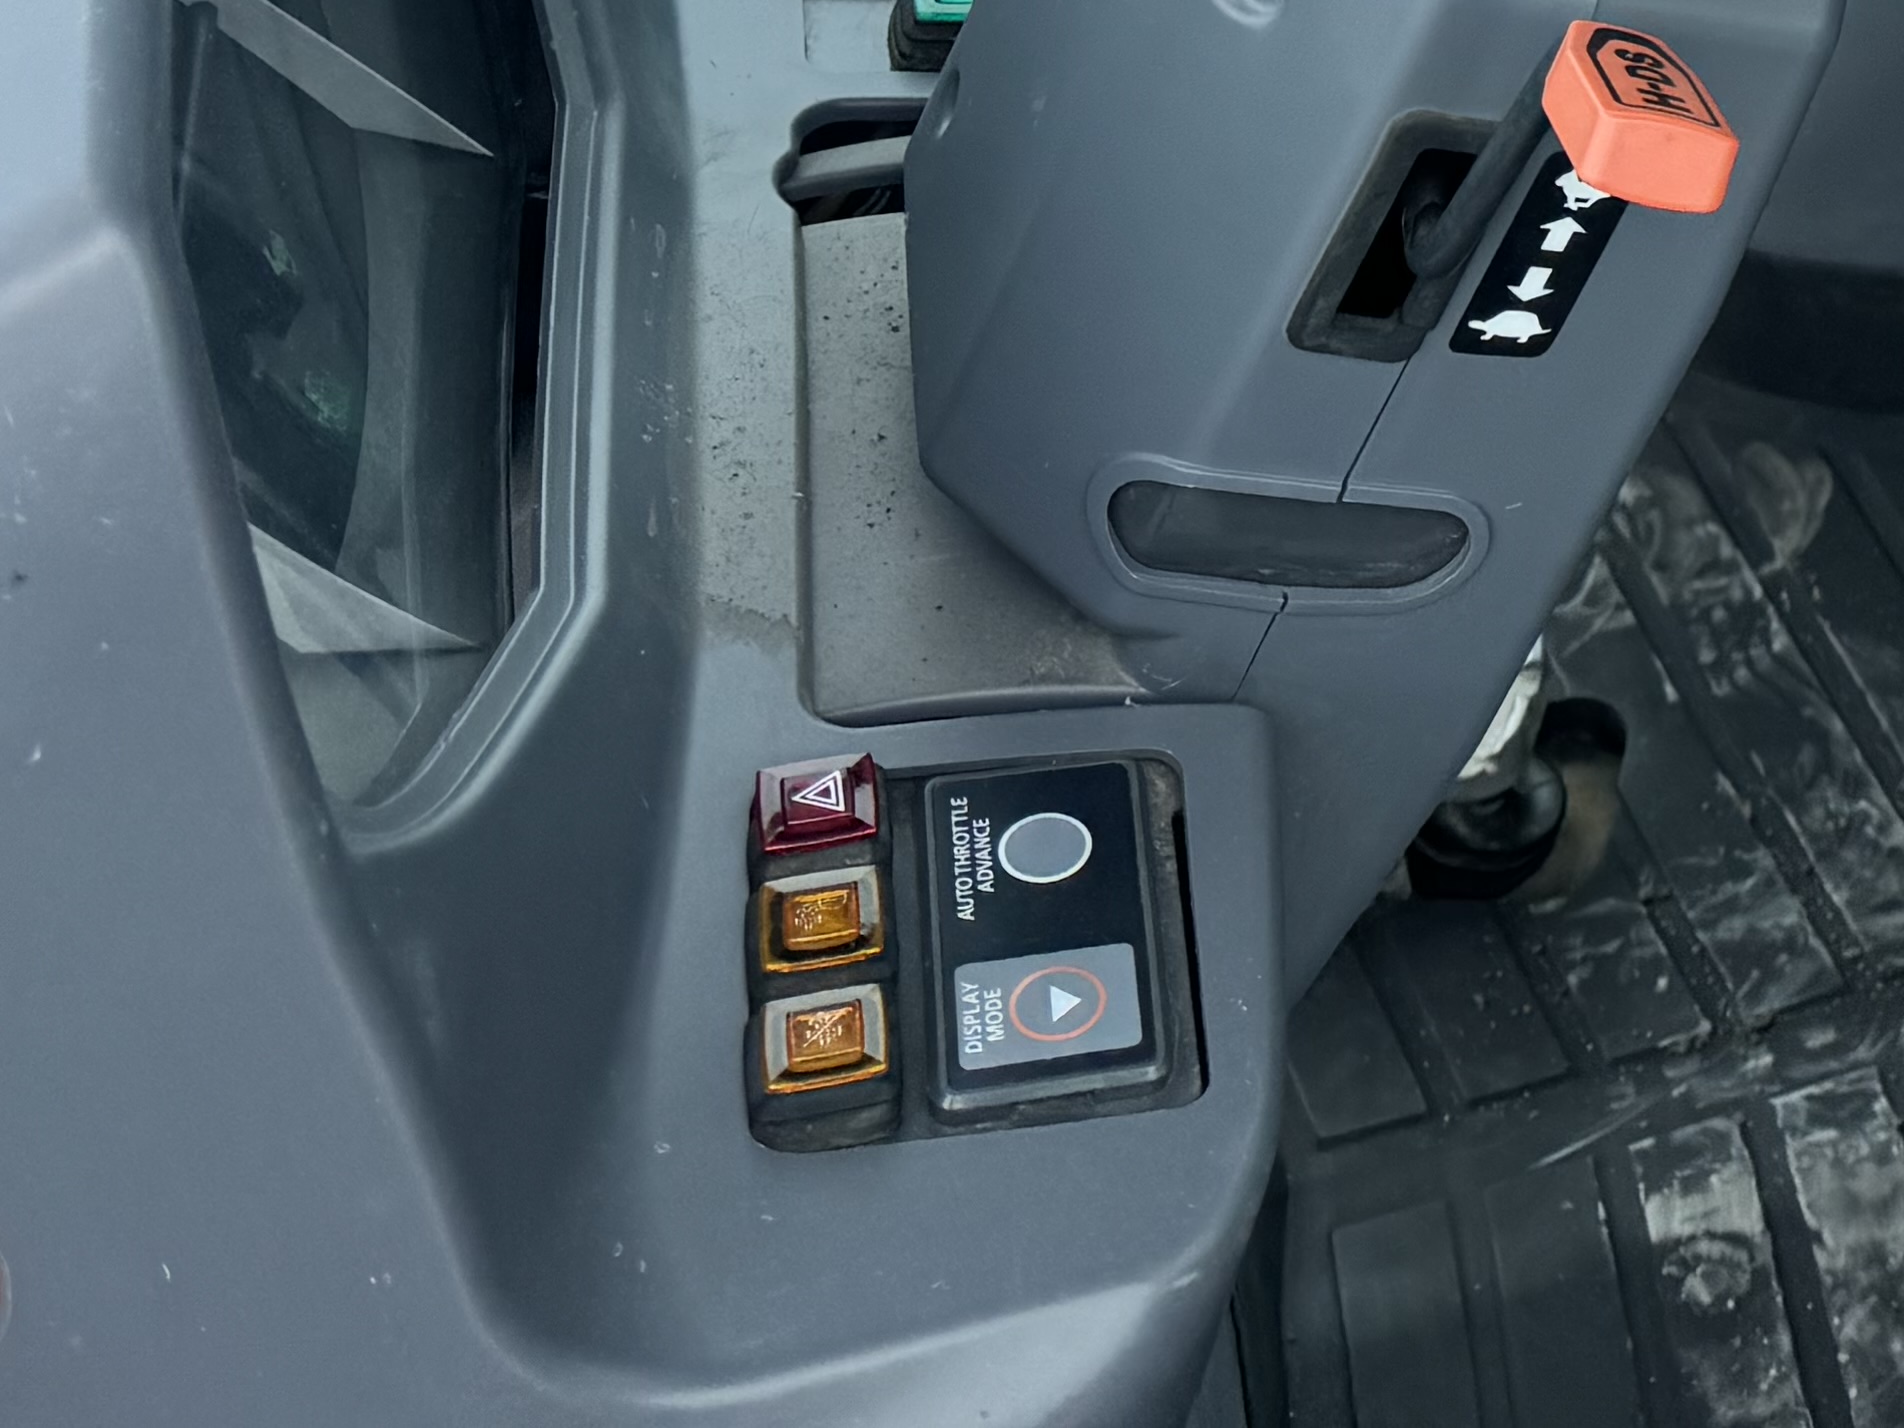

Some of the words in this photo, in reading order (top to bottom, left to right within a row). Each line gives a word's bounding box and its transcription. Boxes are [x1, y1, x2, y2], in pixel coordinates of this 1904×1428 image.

[950, 796, 972, 876] THROTTLE
[973, 817, 995, 893] ADVANCE
[955, 877, 975, 921] AUTO
[960, 981, 983, 1054] DISPLAY
[984, 987, 1004, 1043] MODE
